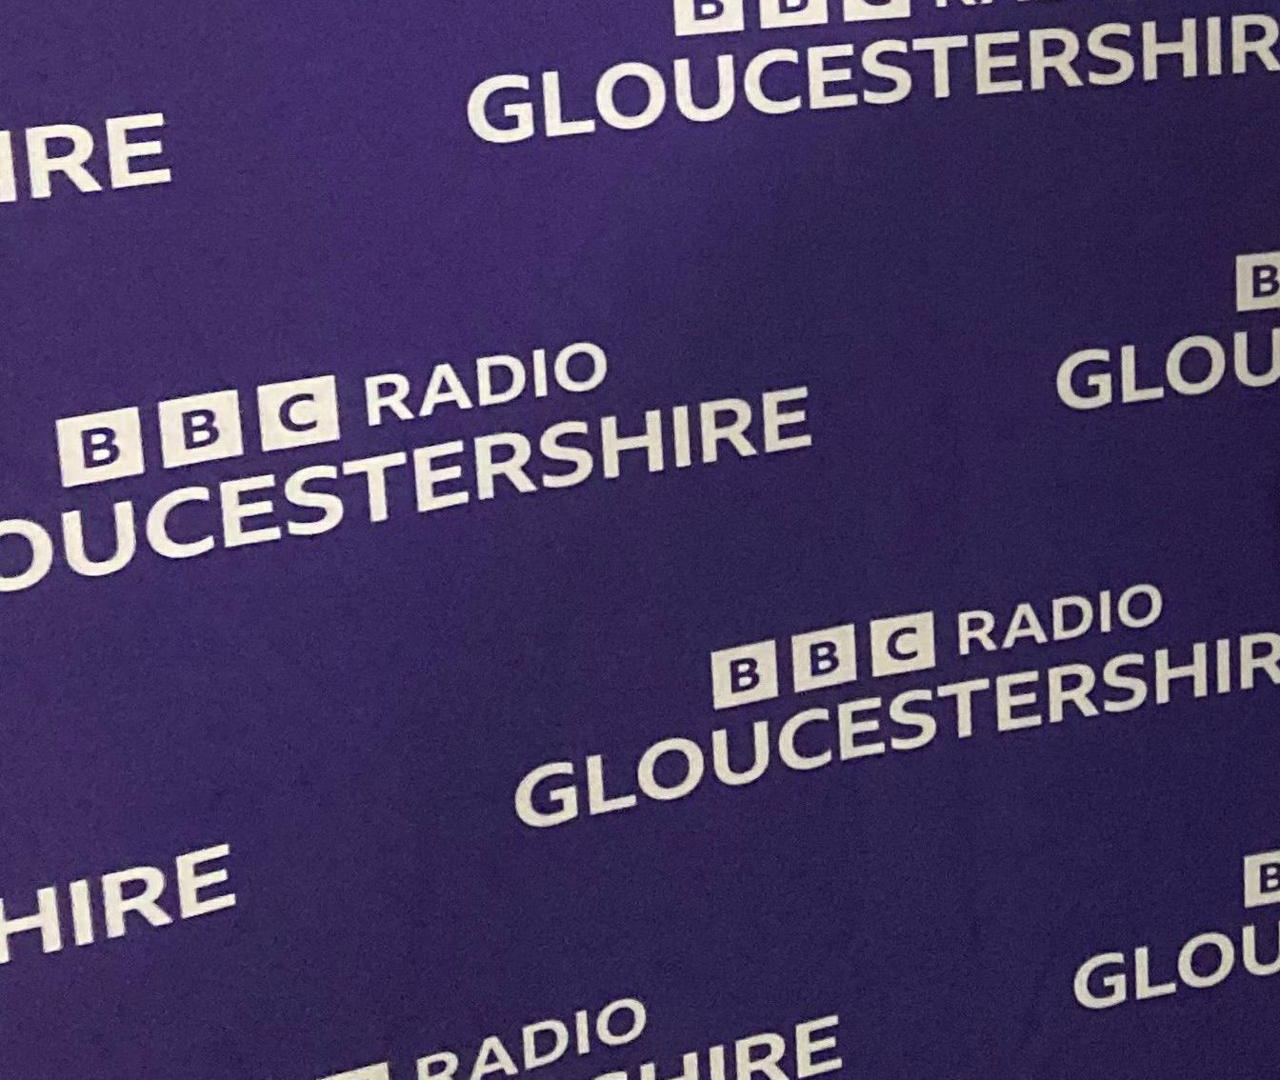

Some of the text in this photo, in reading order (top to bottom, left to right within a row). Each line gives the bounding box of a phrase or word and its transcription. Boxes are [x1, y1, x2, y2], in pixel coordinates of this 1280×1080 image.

[78, 342, 608, 472] BBC RADIO
[726, 584, 1162, 697] BBC RADIO
[417, 998, 647, 1080] RADIO
